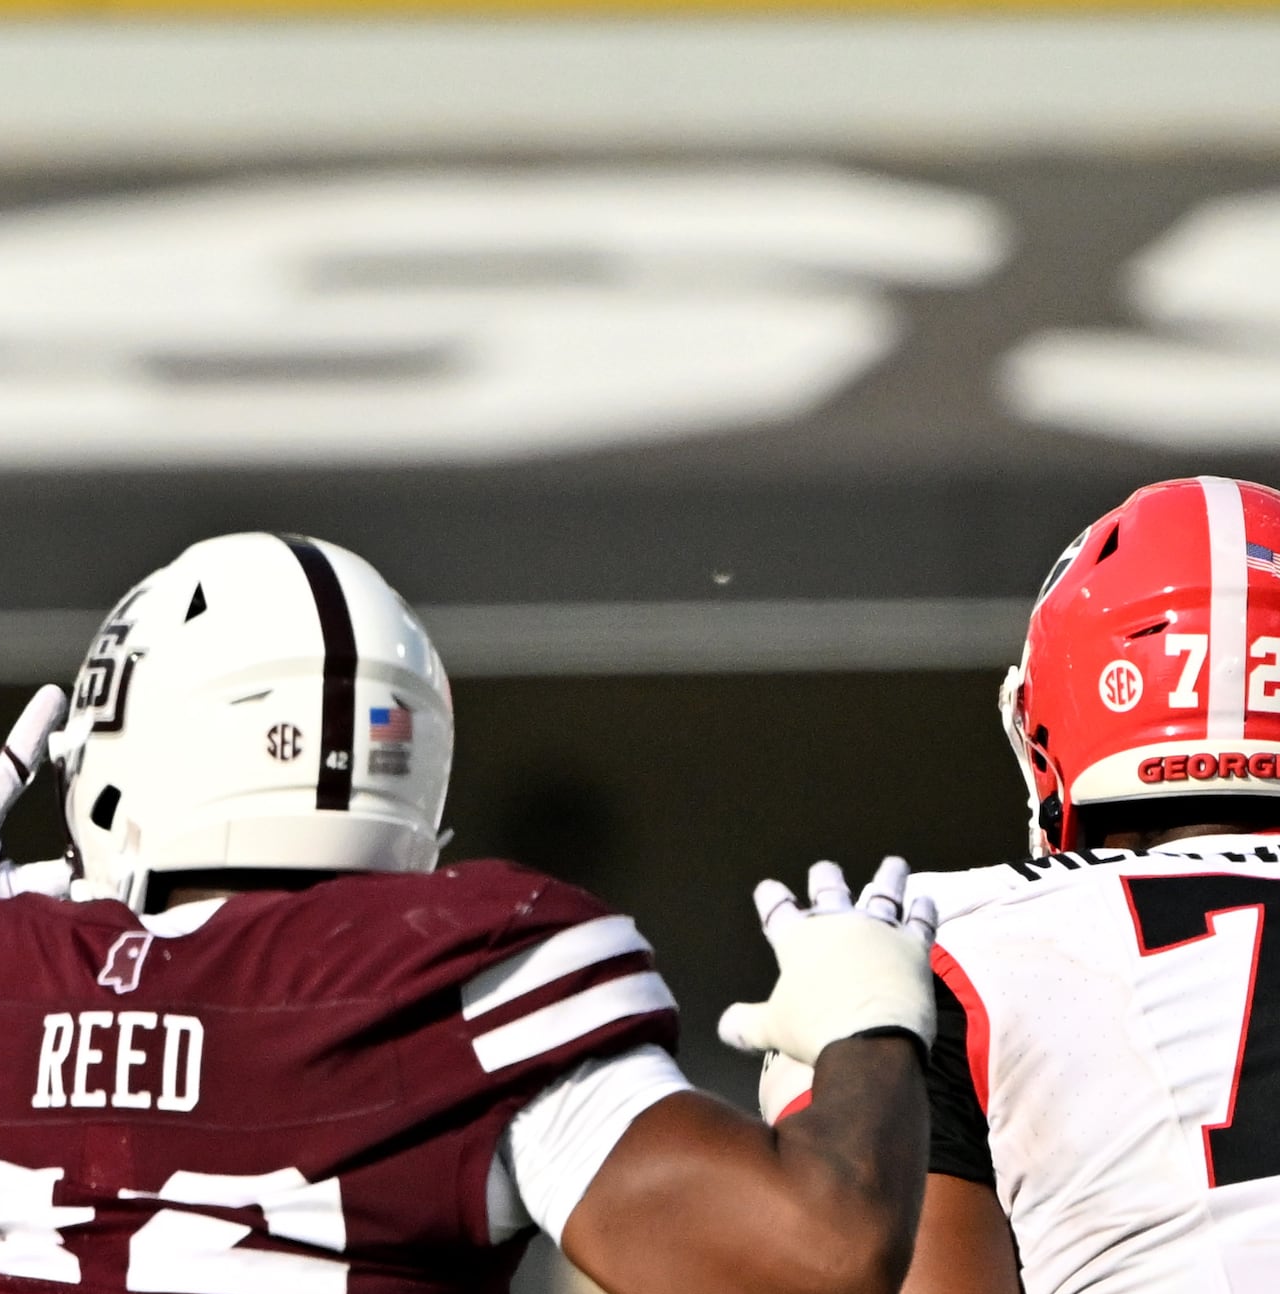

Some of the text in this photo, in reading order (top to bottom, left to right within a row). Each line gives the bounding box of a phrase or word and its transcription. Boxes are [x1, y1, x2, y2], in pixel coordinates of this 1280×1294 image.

[1104, 666, 1137, 706] SEC
[267, 723, 302, 761] SEC
[326, 751, 348, 770] 42
[31, 1012, 204, 1112] REED
